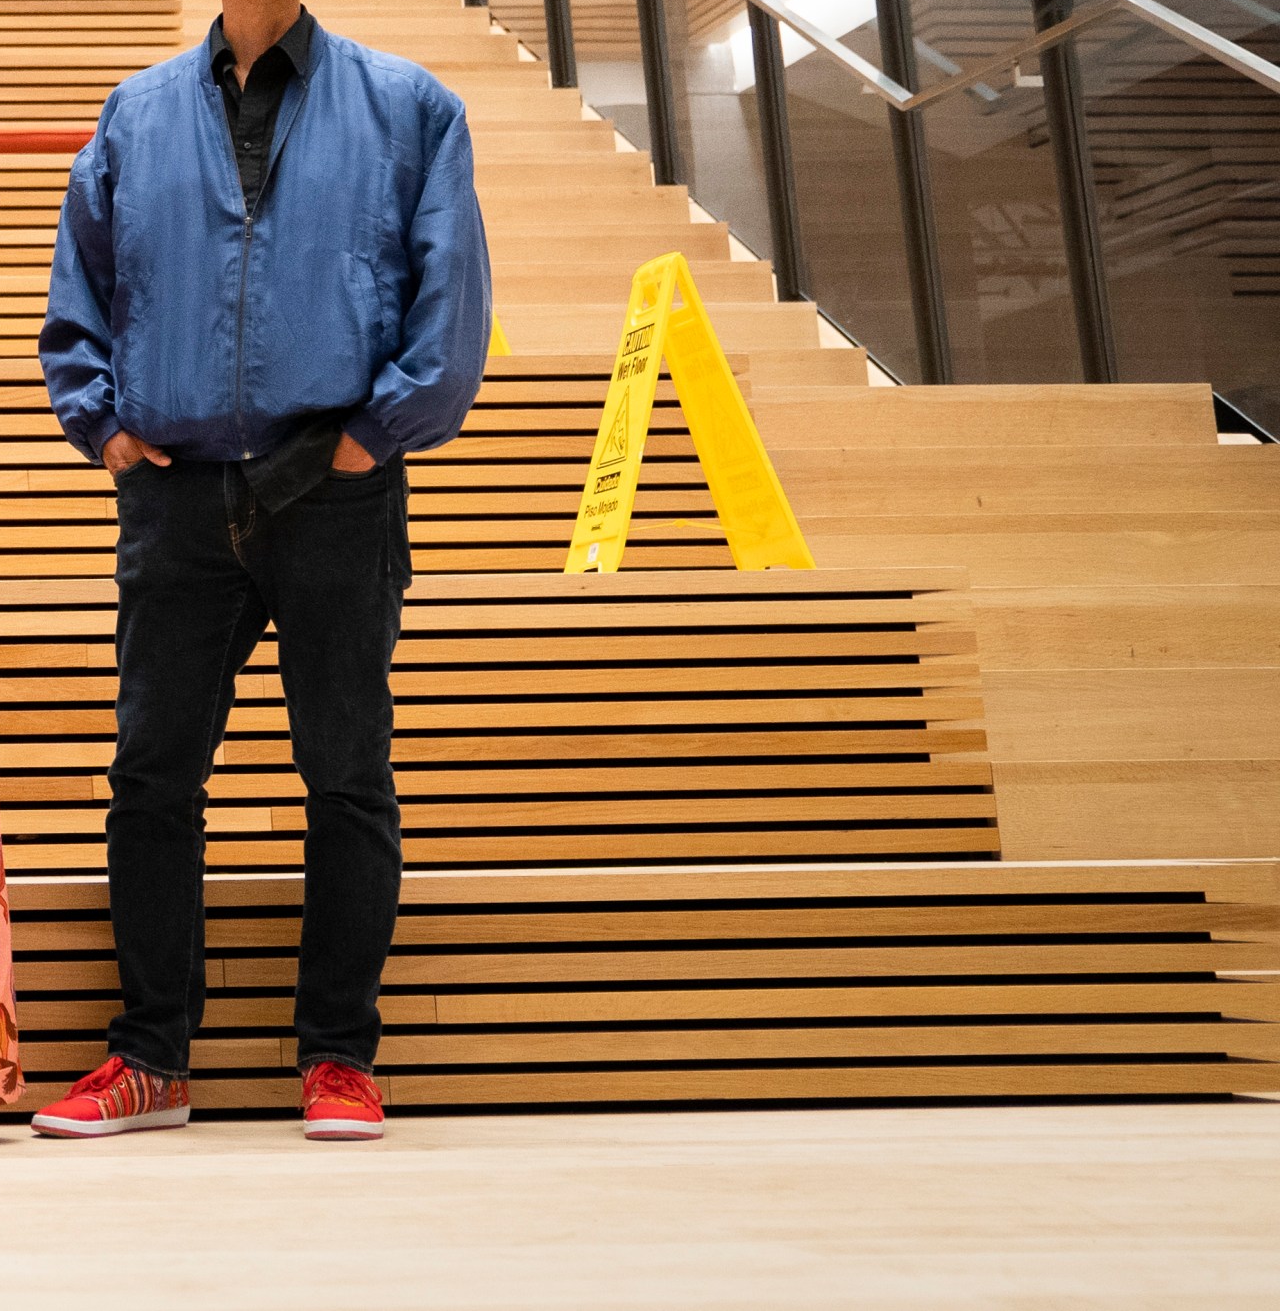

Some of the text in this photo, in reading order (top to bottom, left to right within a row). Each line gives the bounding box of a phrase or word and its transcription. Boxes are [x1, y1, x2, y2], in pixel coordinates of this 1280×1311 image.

[623, 324, 654, 356] CAUTION
[617, 356, 648, 382] Wet Floor
[584, 498, 618, 519] Piso Mojado
